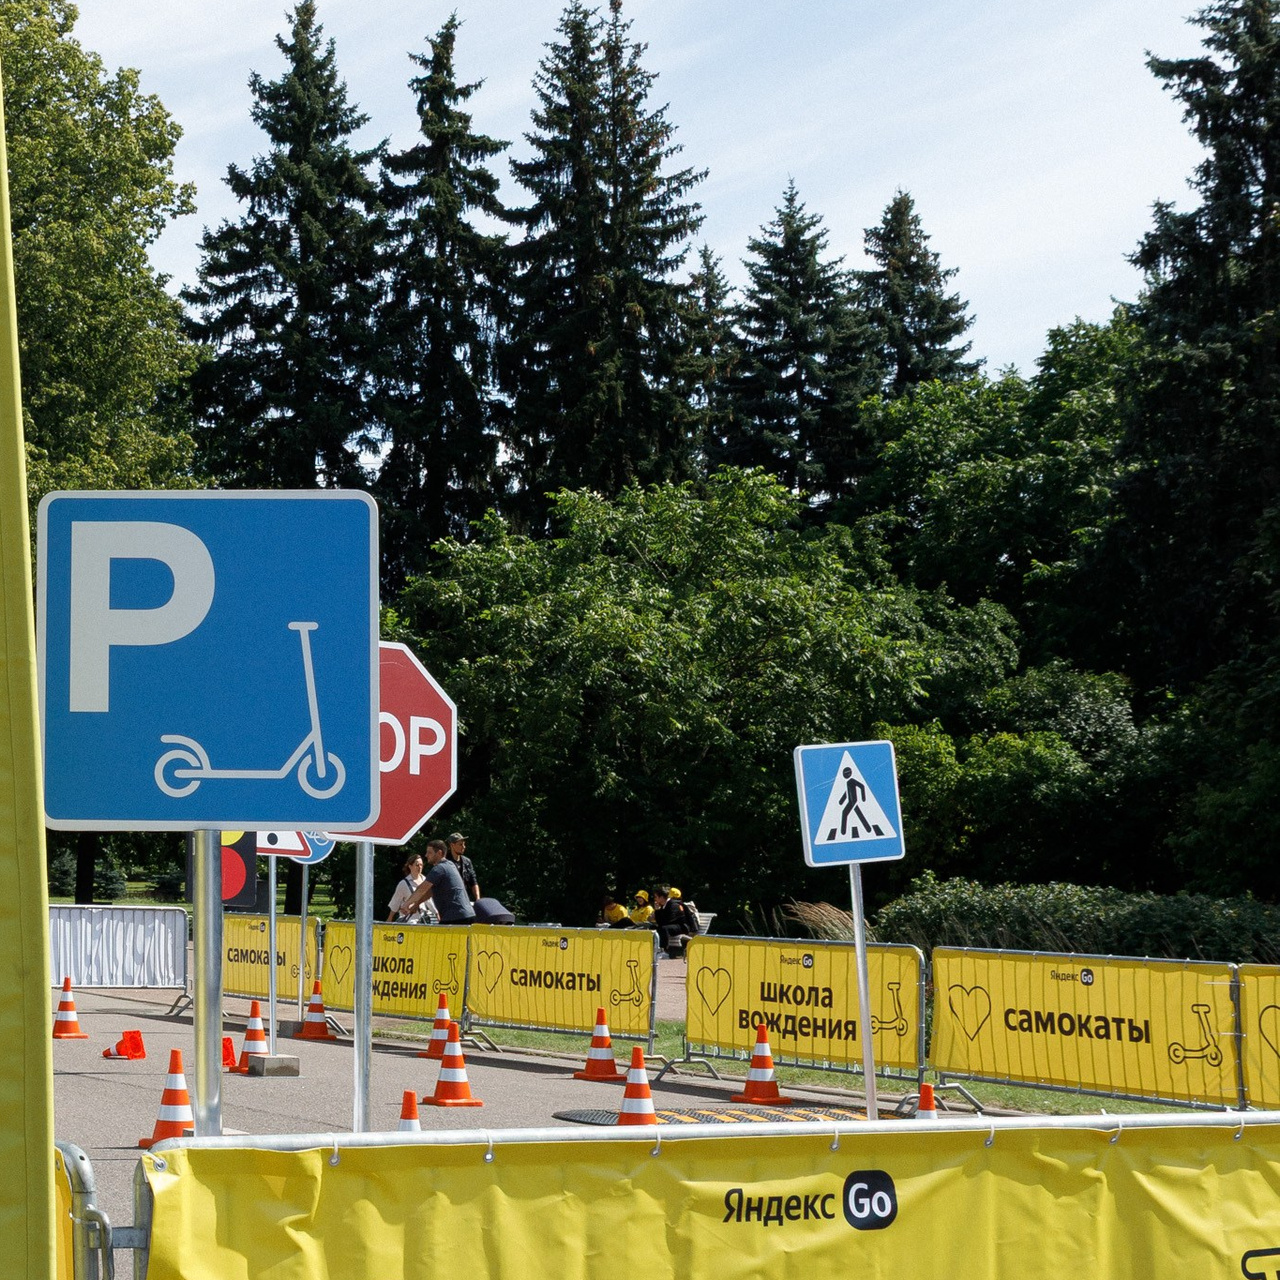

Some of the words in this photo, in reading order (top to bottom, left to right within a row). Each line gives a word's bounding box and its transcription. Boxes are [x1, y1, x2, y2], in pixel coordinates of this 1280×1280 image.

[69, 520, 216, 713] P
[379, 711, 447, 776] OP
[227, 947, 286, 967] самокаы
[803, 956, 813, 967] Go
[510, 968, 601, 992] самокаты
[1050, 970, 1079, 981] Яндекс
[1081, 971, 1093, 983] Go
[372, 980, 428, 1001] ждения
[760, 981, 833, 1008] школа
[738, 1008, 857, 1041] вождения
[1004, 1007, 1151, 1044] самокаты
[722, 1187, 836, 1227] Яндекс
[848, 1182, 892, 1219] Go
